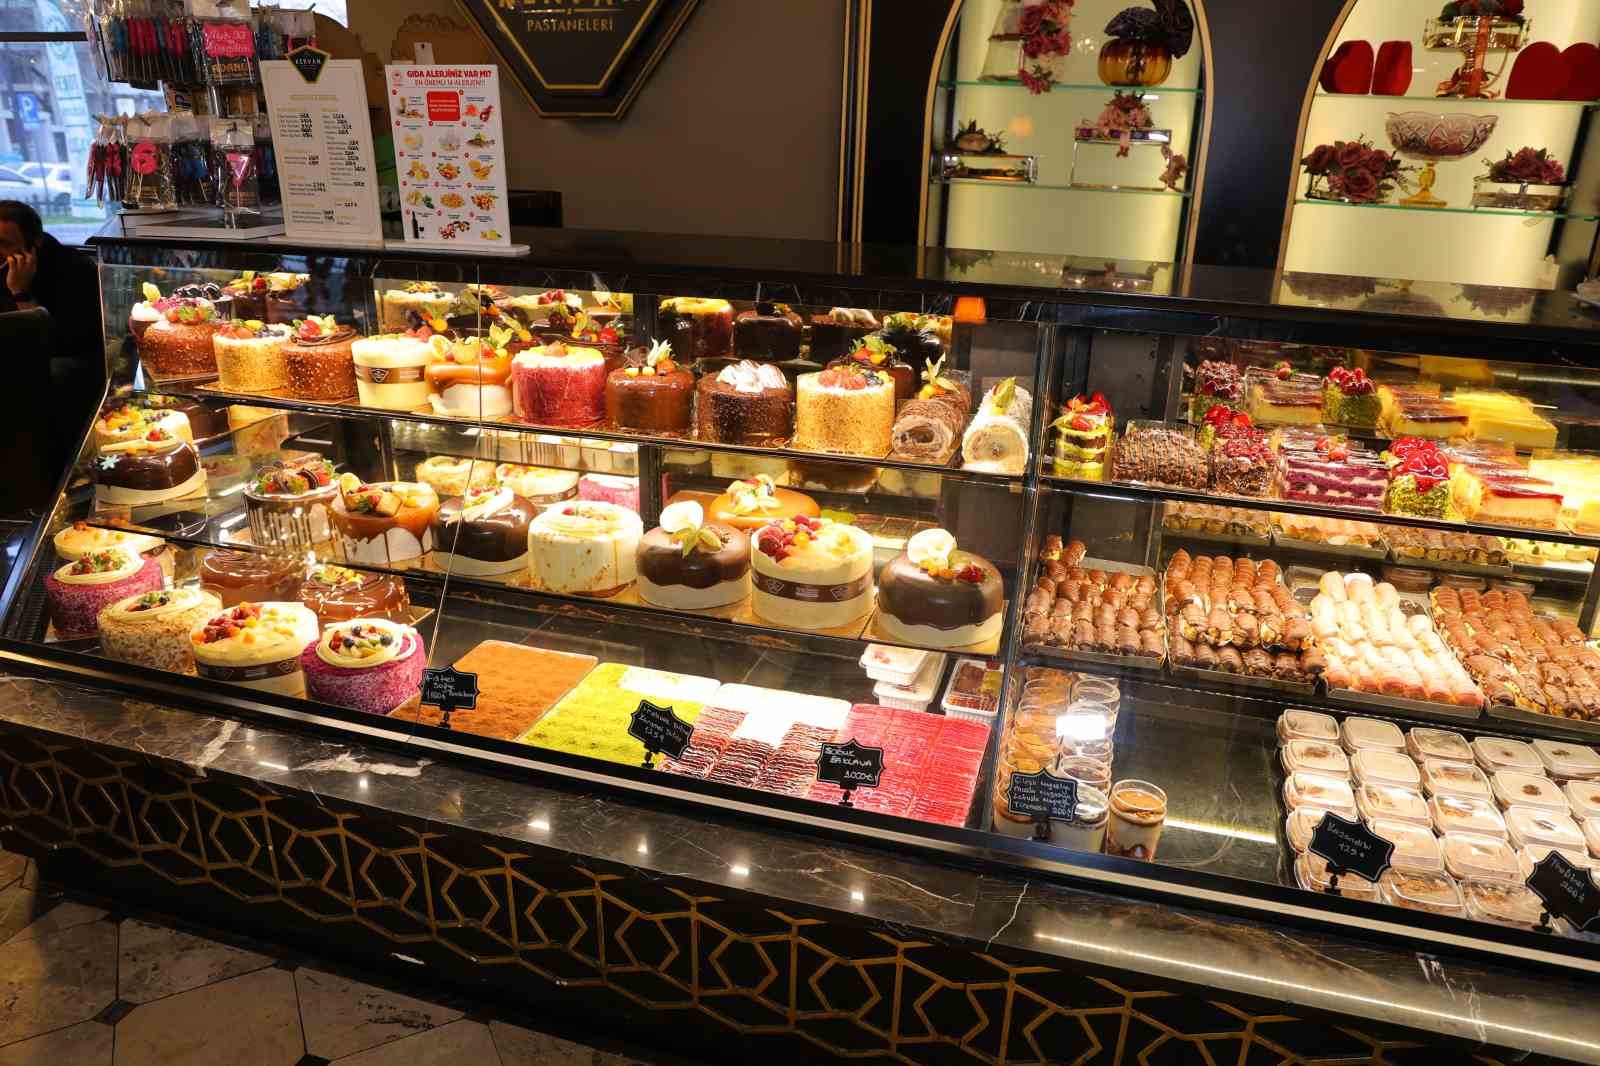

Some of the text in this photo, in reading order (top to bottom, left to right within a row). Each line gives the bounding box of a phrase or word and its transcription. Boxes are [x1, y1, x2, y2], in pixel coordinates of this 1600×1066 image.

[527, 17, 614, 32] PASTANELERİ
[407, 70, 425, 78] GIDA
[464, 70, 479, 78] VAR
